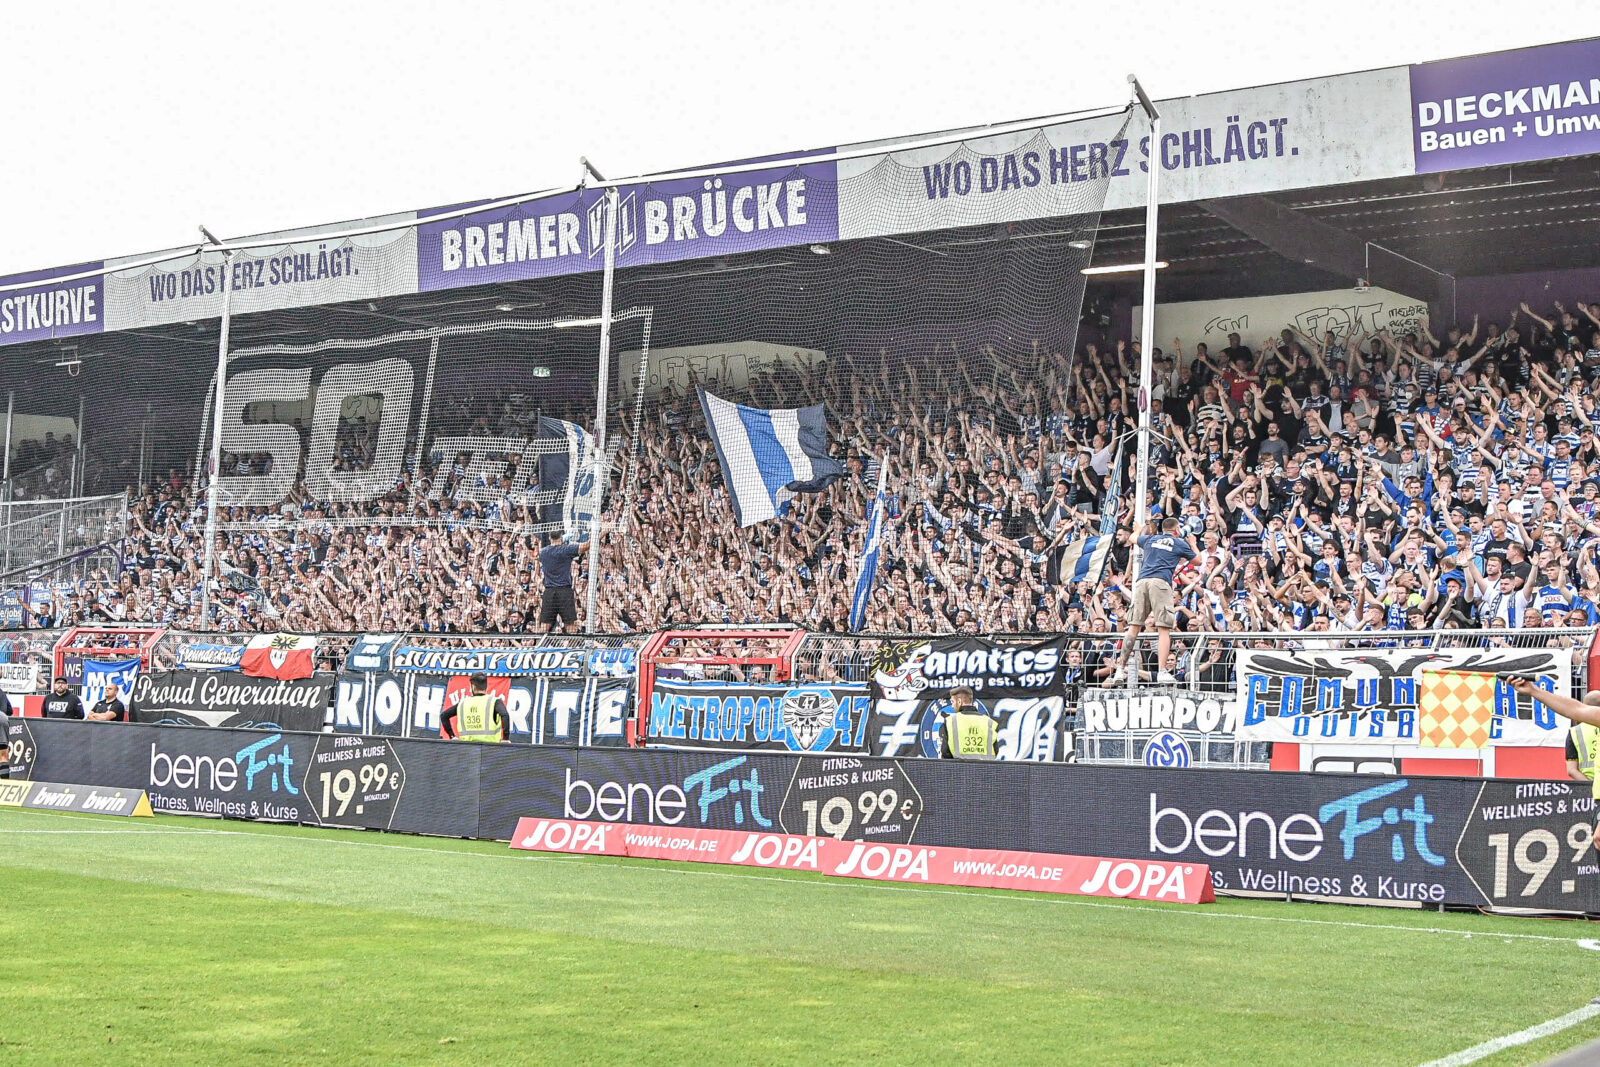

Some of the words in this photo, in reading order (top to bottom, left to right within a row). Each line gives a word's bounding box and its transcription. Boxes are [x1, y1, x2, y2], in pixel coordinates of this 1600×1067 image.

[1420, 126, 1506, 152] Bauen
[1512, 121, 1527, 137] +
[923, 161, 971, 200] WO
[980, 151, 1042, 194] DAS
[1049, 139, 1129, 185] HERZ
[442, 213, 582, 271] BREMER
[645, 179, 807, 245] BRÜCKE
[150, 275, 177, 302] WO
[181, 267, 215, 298] DAS
[269, 244, 359, 287] SCHLÄGT.
[0, 285, 96, 334] STKURVE
[64, 664, 81, 677] W5
[897, 645, 1058, 678] Fanatics
[134, 675, 196, 704] Proud
[201, 676, 320, 709] Generation
[988, 677, 1015, 688] est.
[1018, 672, 1056, 687] 1997
[48, 702, 68, 713] MSV
[335, 680, 630, 738] KOHRTE
[649, 692, 787, 743] METROPOL
[834, 696, 870, 747] 47
[1084, 696, 1236, 733] RUHRPOT
[317, 750, 353, 763] WELLNESS
[354, 748, 361, 758] &
[363, 746, 386, 757] KURSE
[965, 737, 983, 746] 332
[799, 772, 848, 790] WELLNESS
[851, 774, 859, 784] &
[862, 768, 894, 782] KURSE
[1515, 782, 1573, 798] FITNESS,
[32, 786, 76, 807] bwin
[82, 790, 127, 812] bwin
[149, 793, 189, 811] Fitness,
[194, 796, 246, 815] Wellness
[250, 801, 259, 815] &
[263, 802, 298, 819] Kurse
[1482, 801, 1552, 820] WELLNESS
[1556, 800, 1567, 813] &
[625, 833, 718, 852] WWW.JOPA.DE
[865, 824, 900, 835] MONATLICH
[953, 860, 1063, 881] WWW.JOPA.DE
[1238, 868, 1341, 895] Wellness
[1350, 874, 1368, 896] &
[1378, 875, 1445, 901] Kurse
